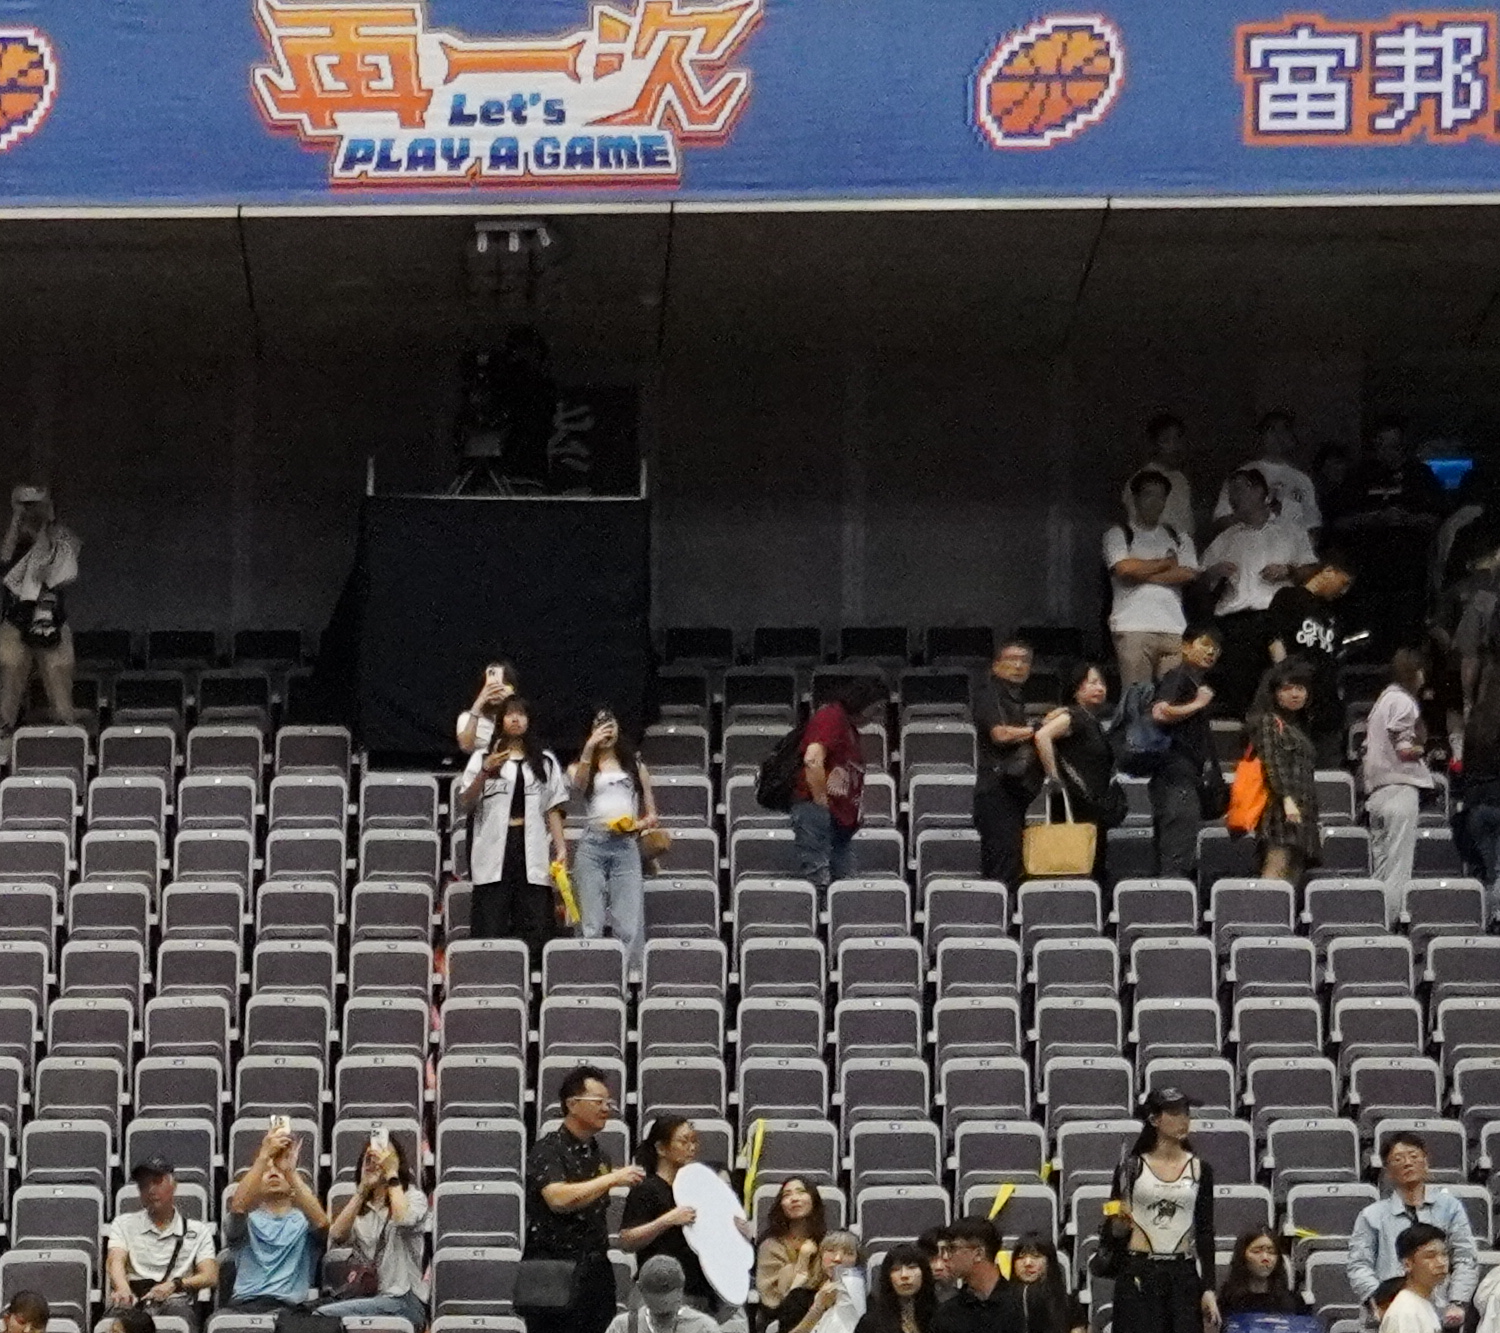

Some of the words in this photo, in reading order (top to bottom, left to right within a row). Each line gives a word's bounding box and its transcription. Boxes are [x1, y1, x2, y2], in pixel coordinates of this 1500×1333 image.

[258, 0, 748, 132] 再一次
[450, 92, 568, 128] Let's
[340, 133, 475, 175] PLAY
[476, 133, 522, 173] A
[532, 133, 674, 173] GAME
